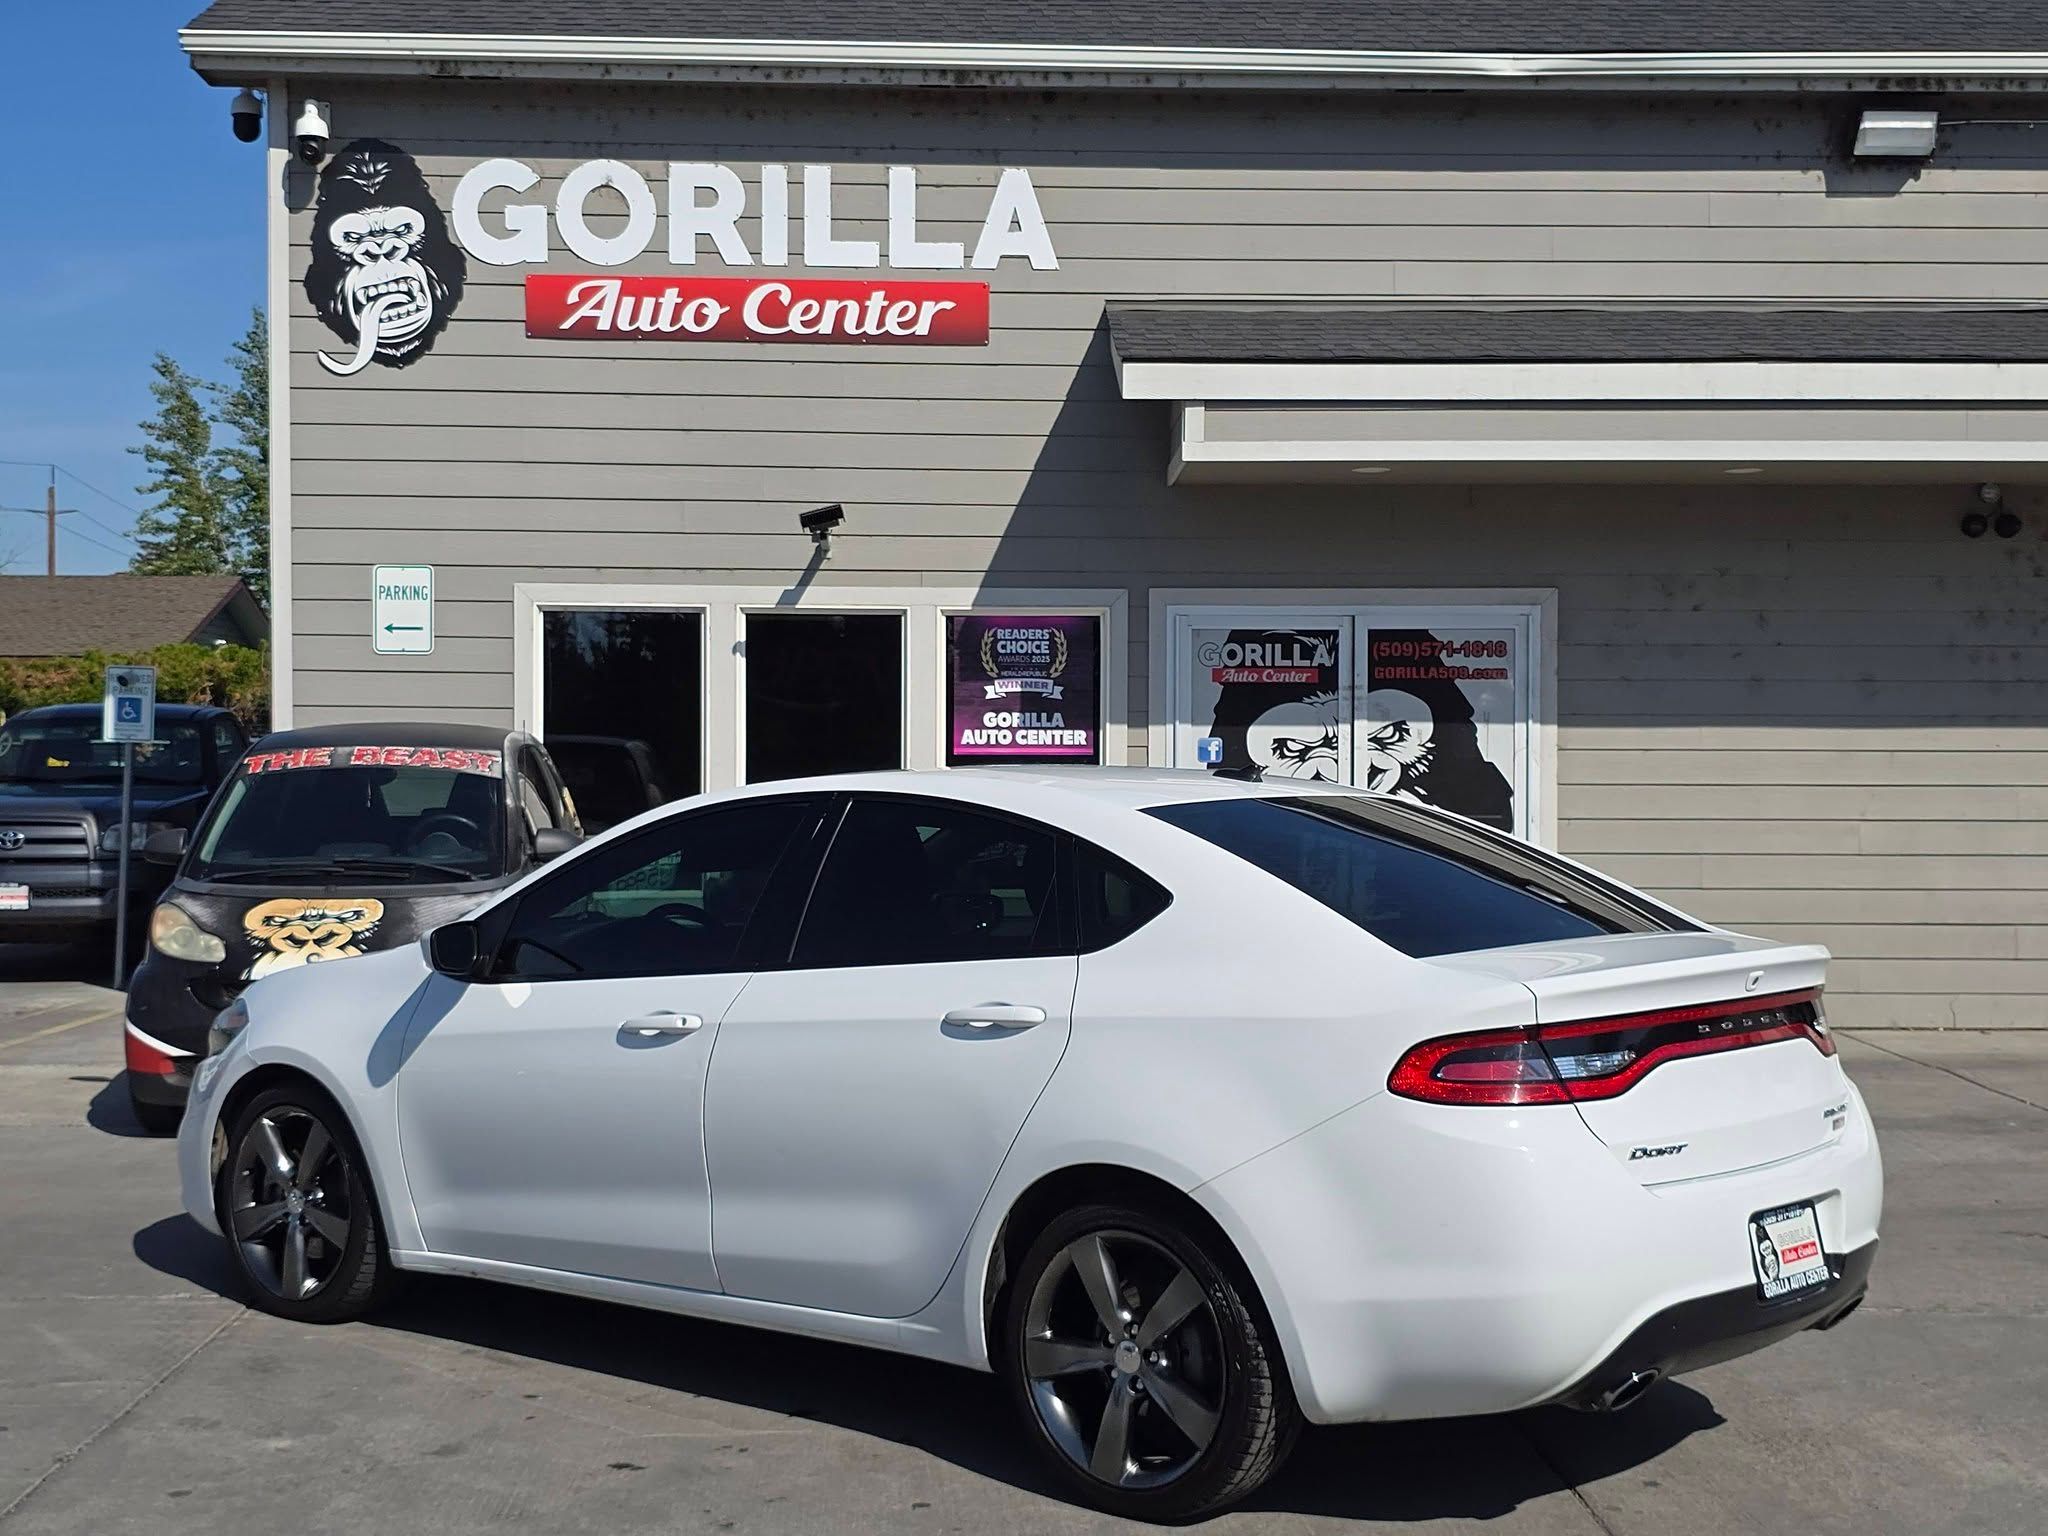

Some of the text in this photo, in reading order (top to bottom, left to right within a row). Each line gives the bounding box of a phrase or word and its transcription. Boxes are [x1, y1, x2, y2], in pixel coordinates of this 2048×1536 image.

[451, 158, 1060, 270] GORILLA
[558, 279, 957, 337] Auto Center
[378, 585, 429, 601] PARKING
[996, 640, 1050, 654] CHOICE
[1197, 641, 1332, 668] GORILLA
[1372, 640, 1508, 661] (509)571-1818
[997, 655, 1030, 663] AWARDS
[1220, 668, 1313, 683] Auto Center
[997, 680, 1049, 690] WINNER
[982, 711, 1066, 728] GORILLA
[960, 729, 1088, 746] AUTO CENTER
[243, 745, 502, 775] THE BEAST
[1764, 1265, 1830, 1298] GORILLA AUTO CENTER
